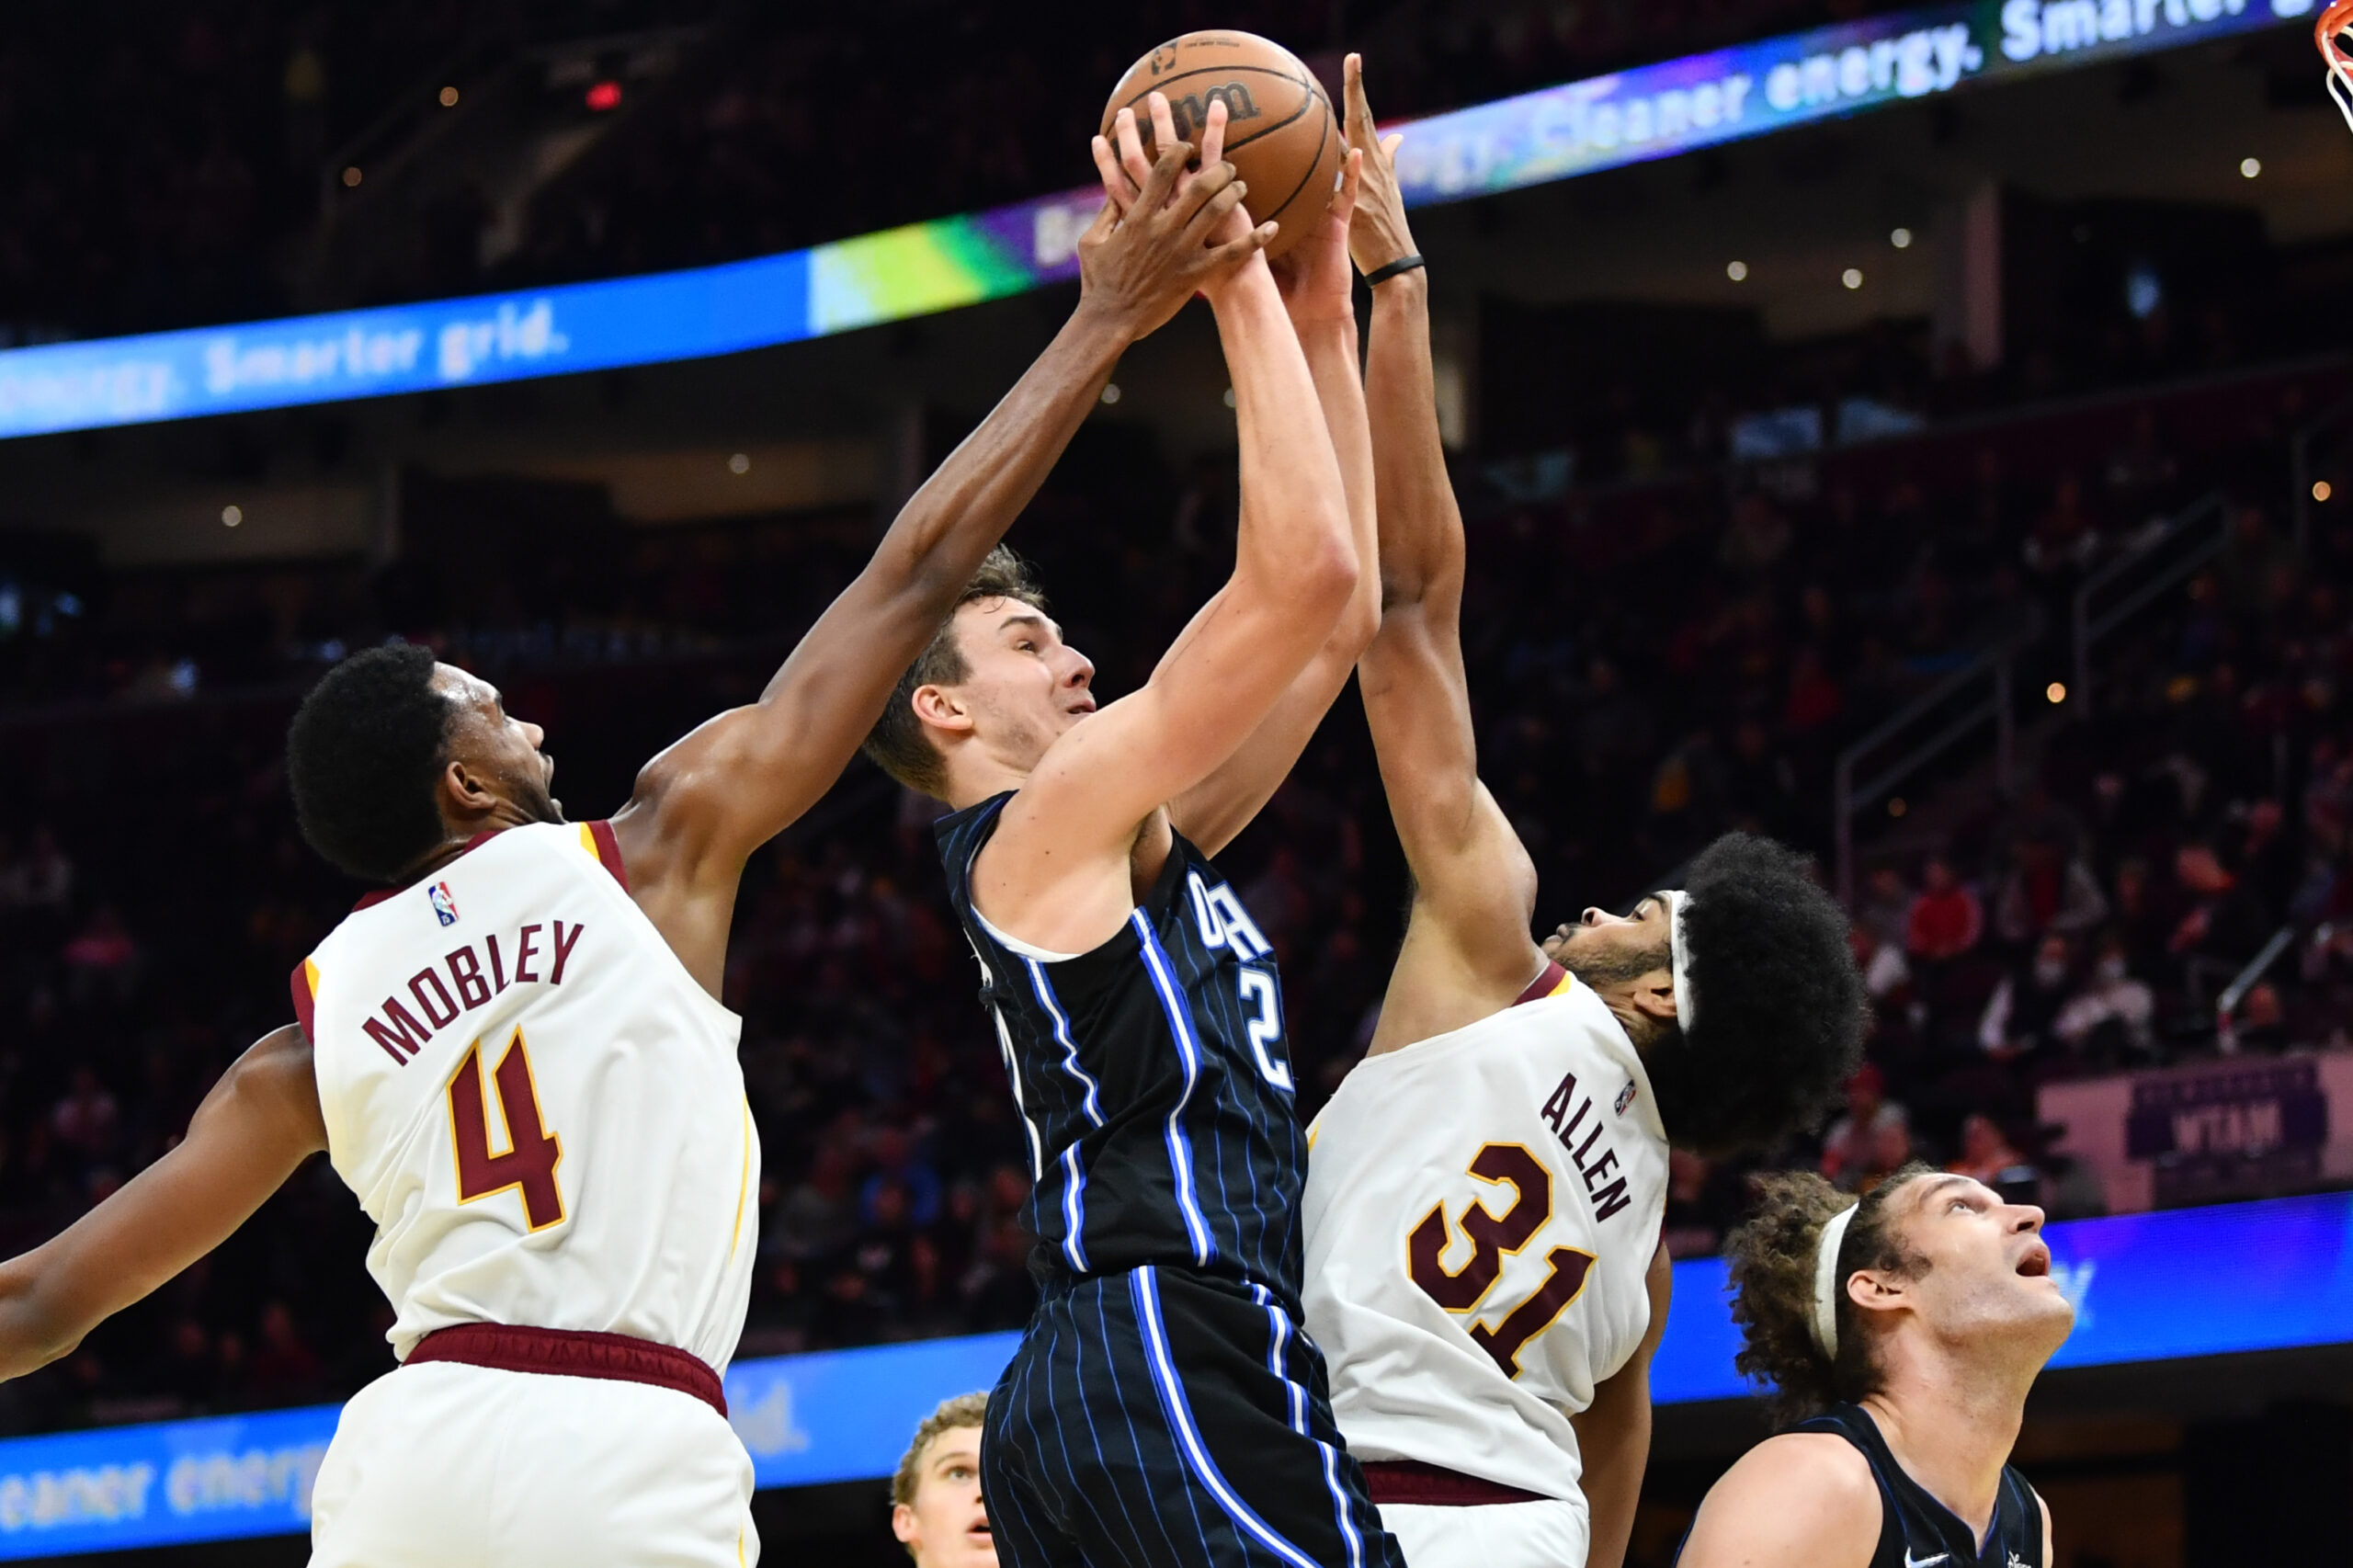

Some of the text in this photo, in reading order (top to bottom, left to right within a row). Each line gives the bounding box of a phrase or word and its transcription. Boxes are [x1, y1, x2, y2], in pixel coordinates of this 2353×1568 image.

[1765, 20, 1983, 110] energy.
[2000, 0, 2245, 62] Smar
[204, 325, 425, 395] Smarter
[438, 296, 570, 382] grid.
[361, 919, 585, 1067] MOBLEY
[446, 1022, 566, 1234] 4
[1540, 1071, 1632, 1224] ALLEN
[1405, 1141, 1598, 1381] 31
